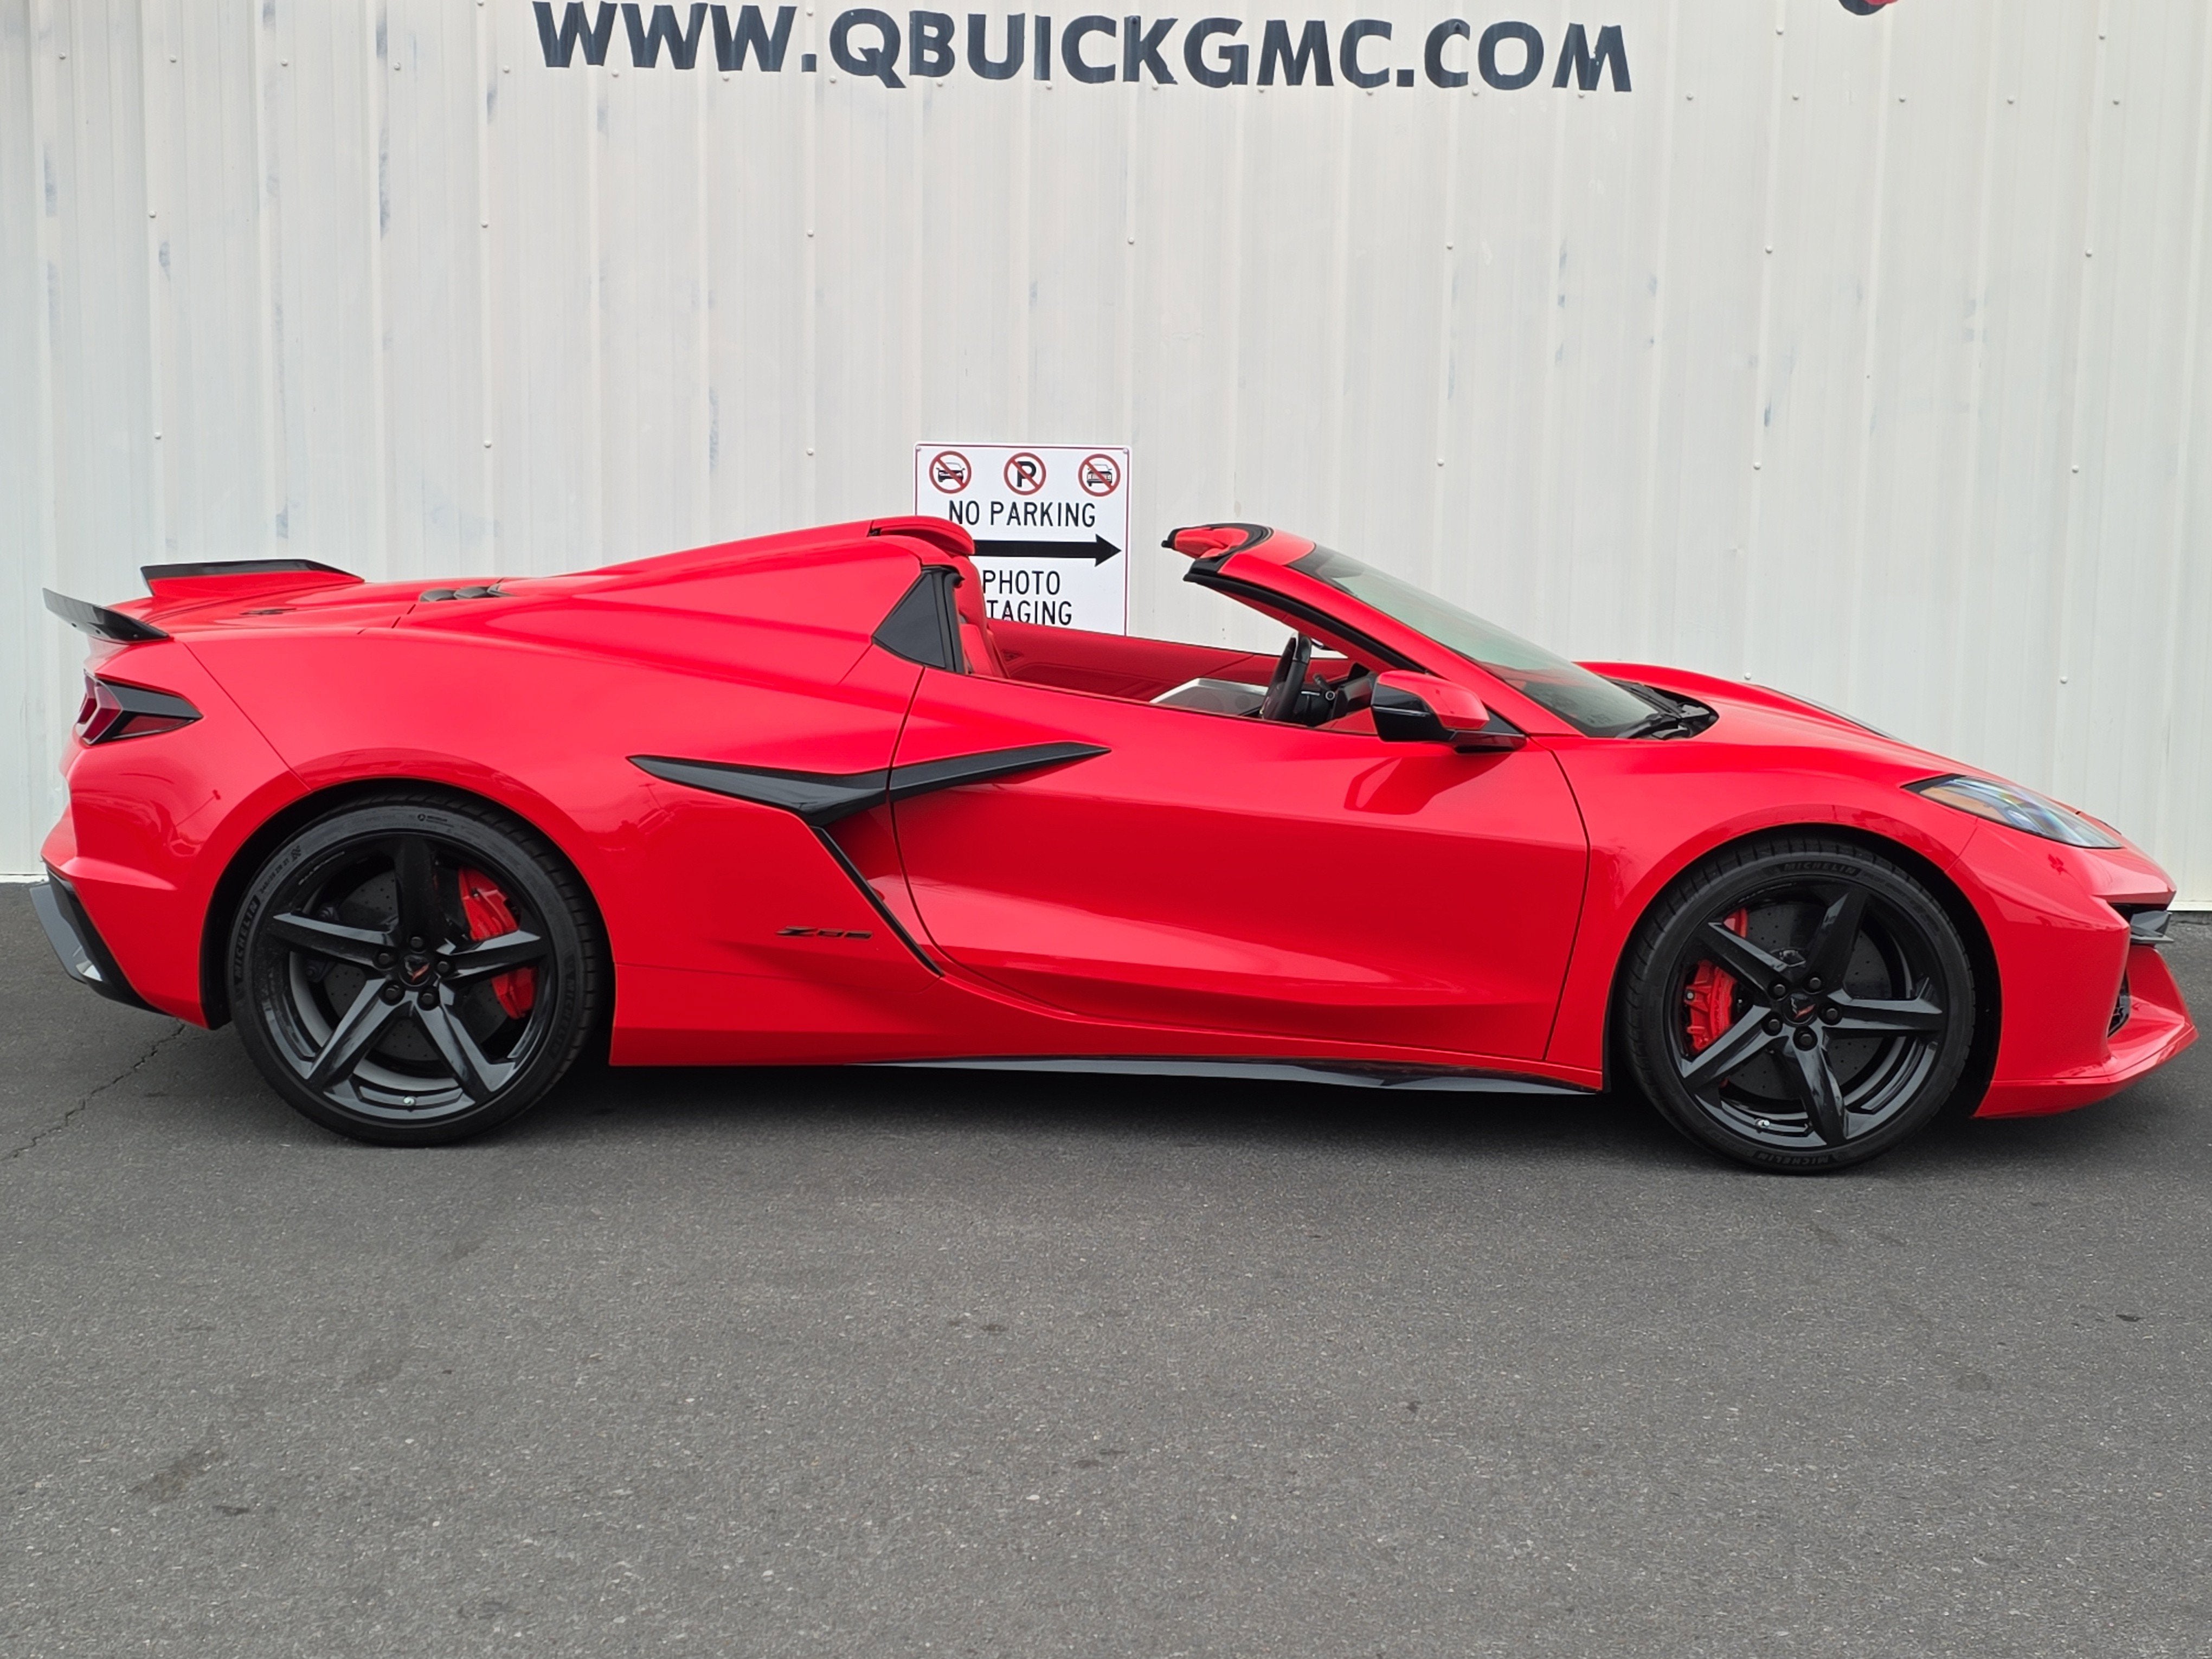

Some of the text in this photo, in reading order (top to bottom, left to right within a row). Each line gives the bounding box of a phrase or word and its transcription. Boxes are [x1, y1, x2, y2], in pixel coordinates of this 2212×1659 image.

[532, 1, 1632, 92] WWW.QBUICKGMC.COM
[949, 500, 1095, 528] NO PARKING
[982, 570, 1060, 595] PHOTO
[986, 600, 1072, 625] TAGING
[234, 901, 258, 979] MICHELIN
